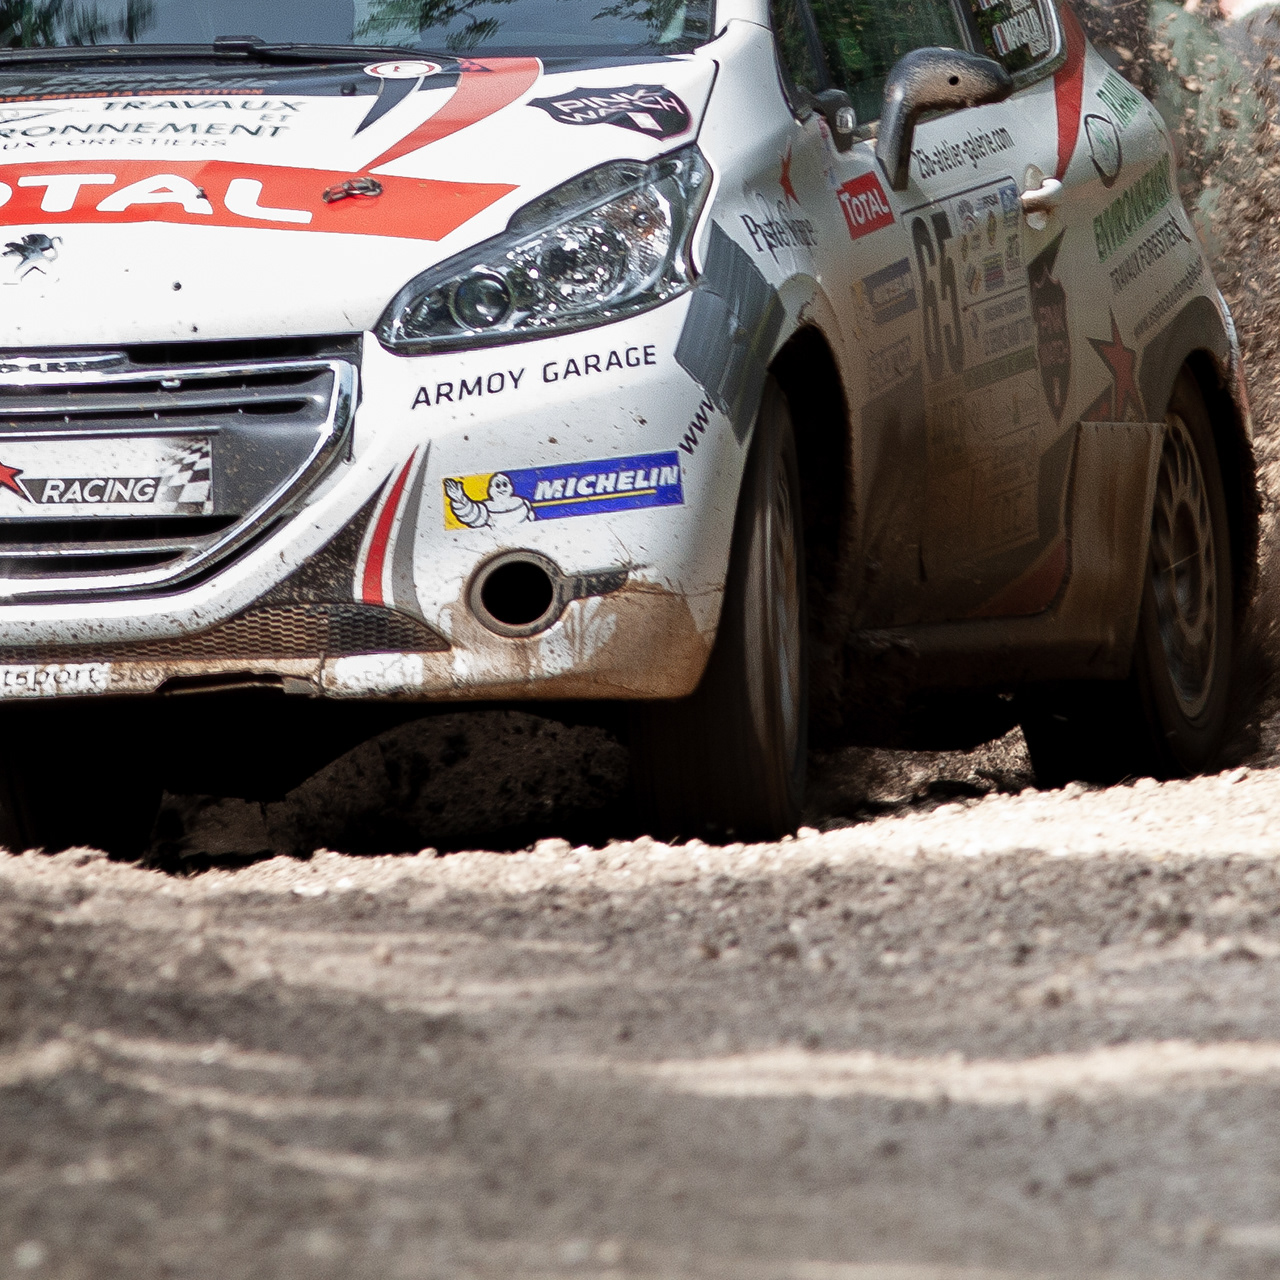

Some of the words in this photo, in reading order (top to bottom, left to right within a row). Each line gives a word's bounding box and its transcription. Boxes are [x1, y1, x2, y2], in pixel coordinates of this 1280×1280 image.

[102, 100, 307, 112] TRAVAUX
[551, 88, 662, 113] PINK
[839, 187, 890, 227] TOTAL
[411, 368, 525, 410] ARMOY
[542, 344, 657, 383] GARAGE
[41, 478, 157, 504] RACING
[534, 465, 681, 501] MICHELIN
